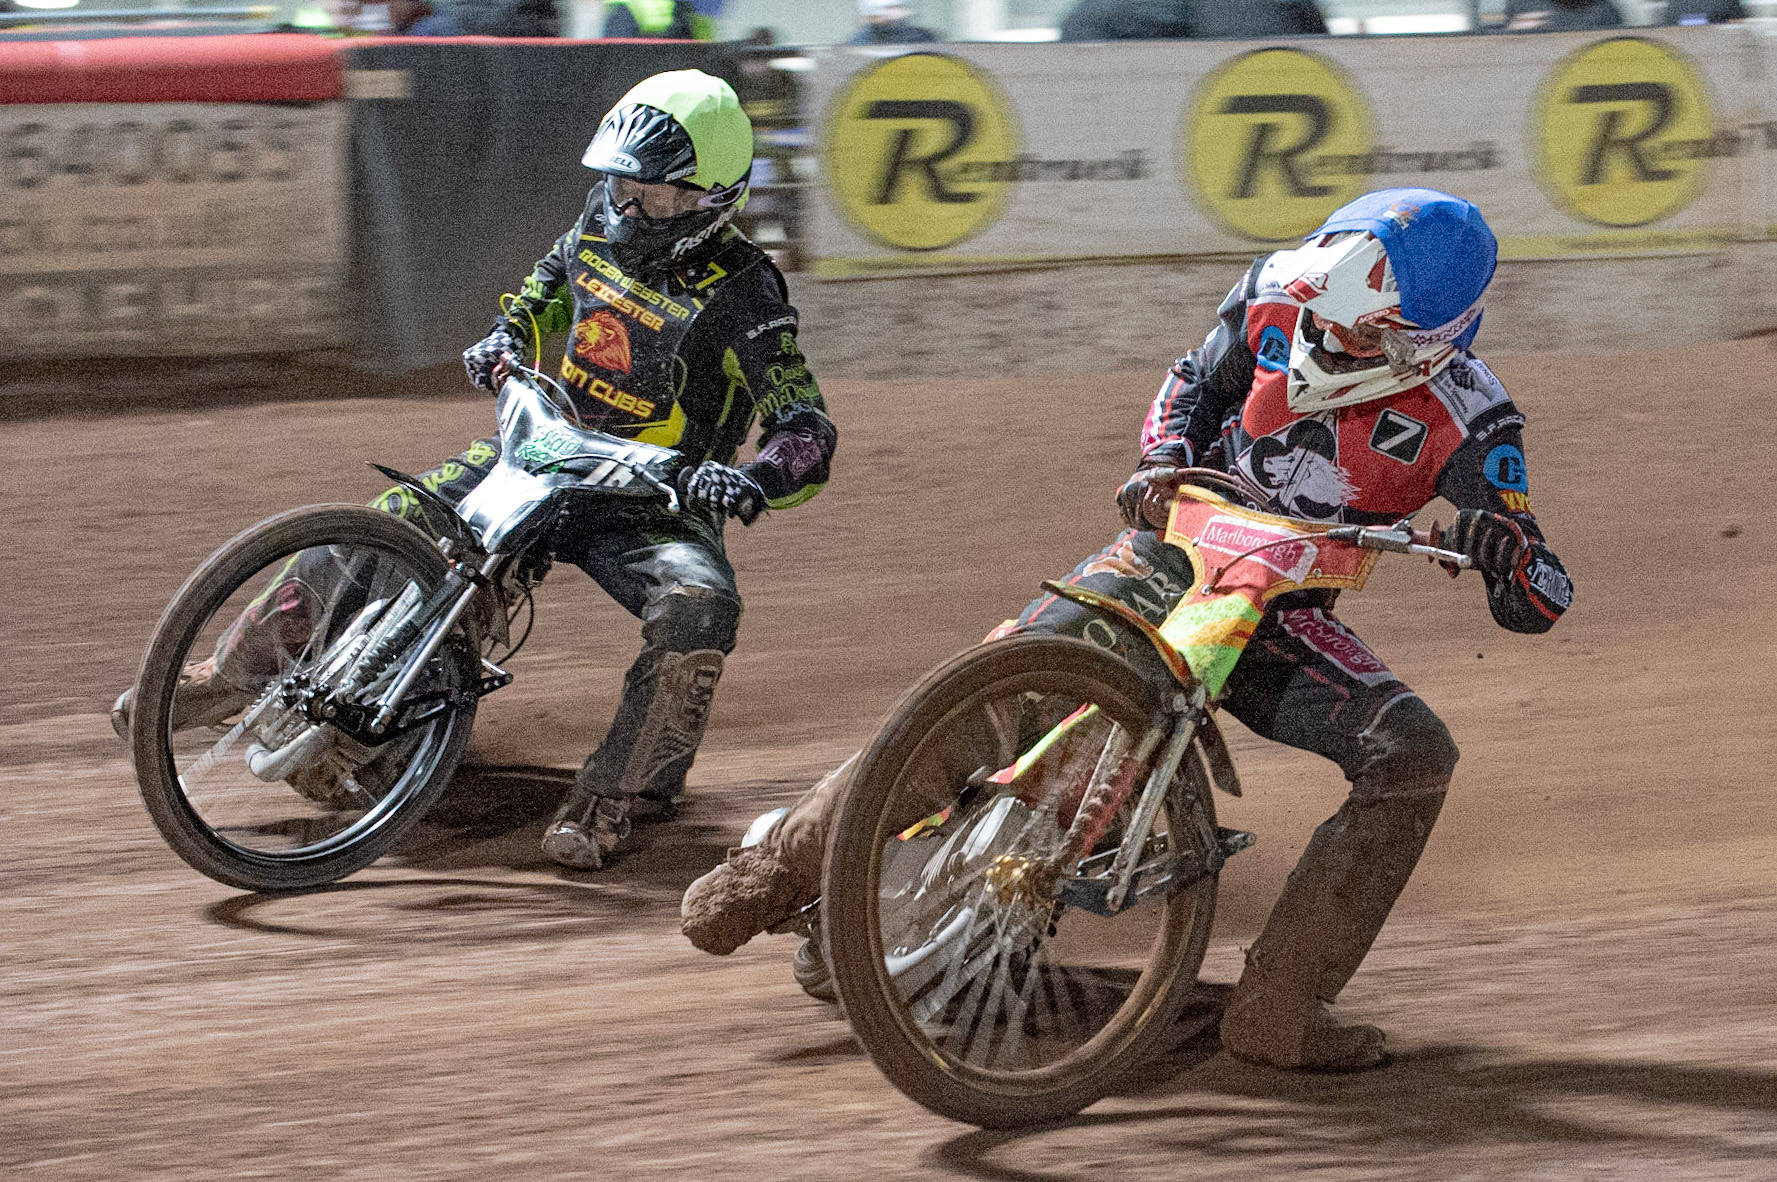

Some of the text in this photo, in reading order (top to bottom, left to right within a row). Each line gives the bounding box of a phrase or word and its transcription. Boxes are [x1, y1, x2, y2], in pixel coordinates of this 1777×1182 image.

[578, 249, 691, 322] ROGER WEBSTER
[695, 261, 728, 291] 7
[575, 270, 666, 333] LEICESTER
[588, 377, 657, 419] CUBS
[1376, 412, 1423, 451] 7
